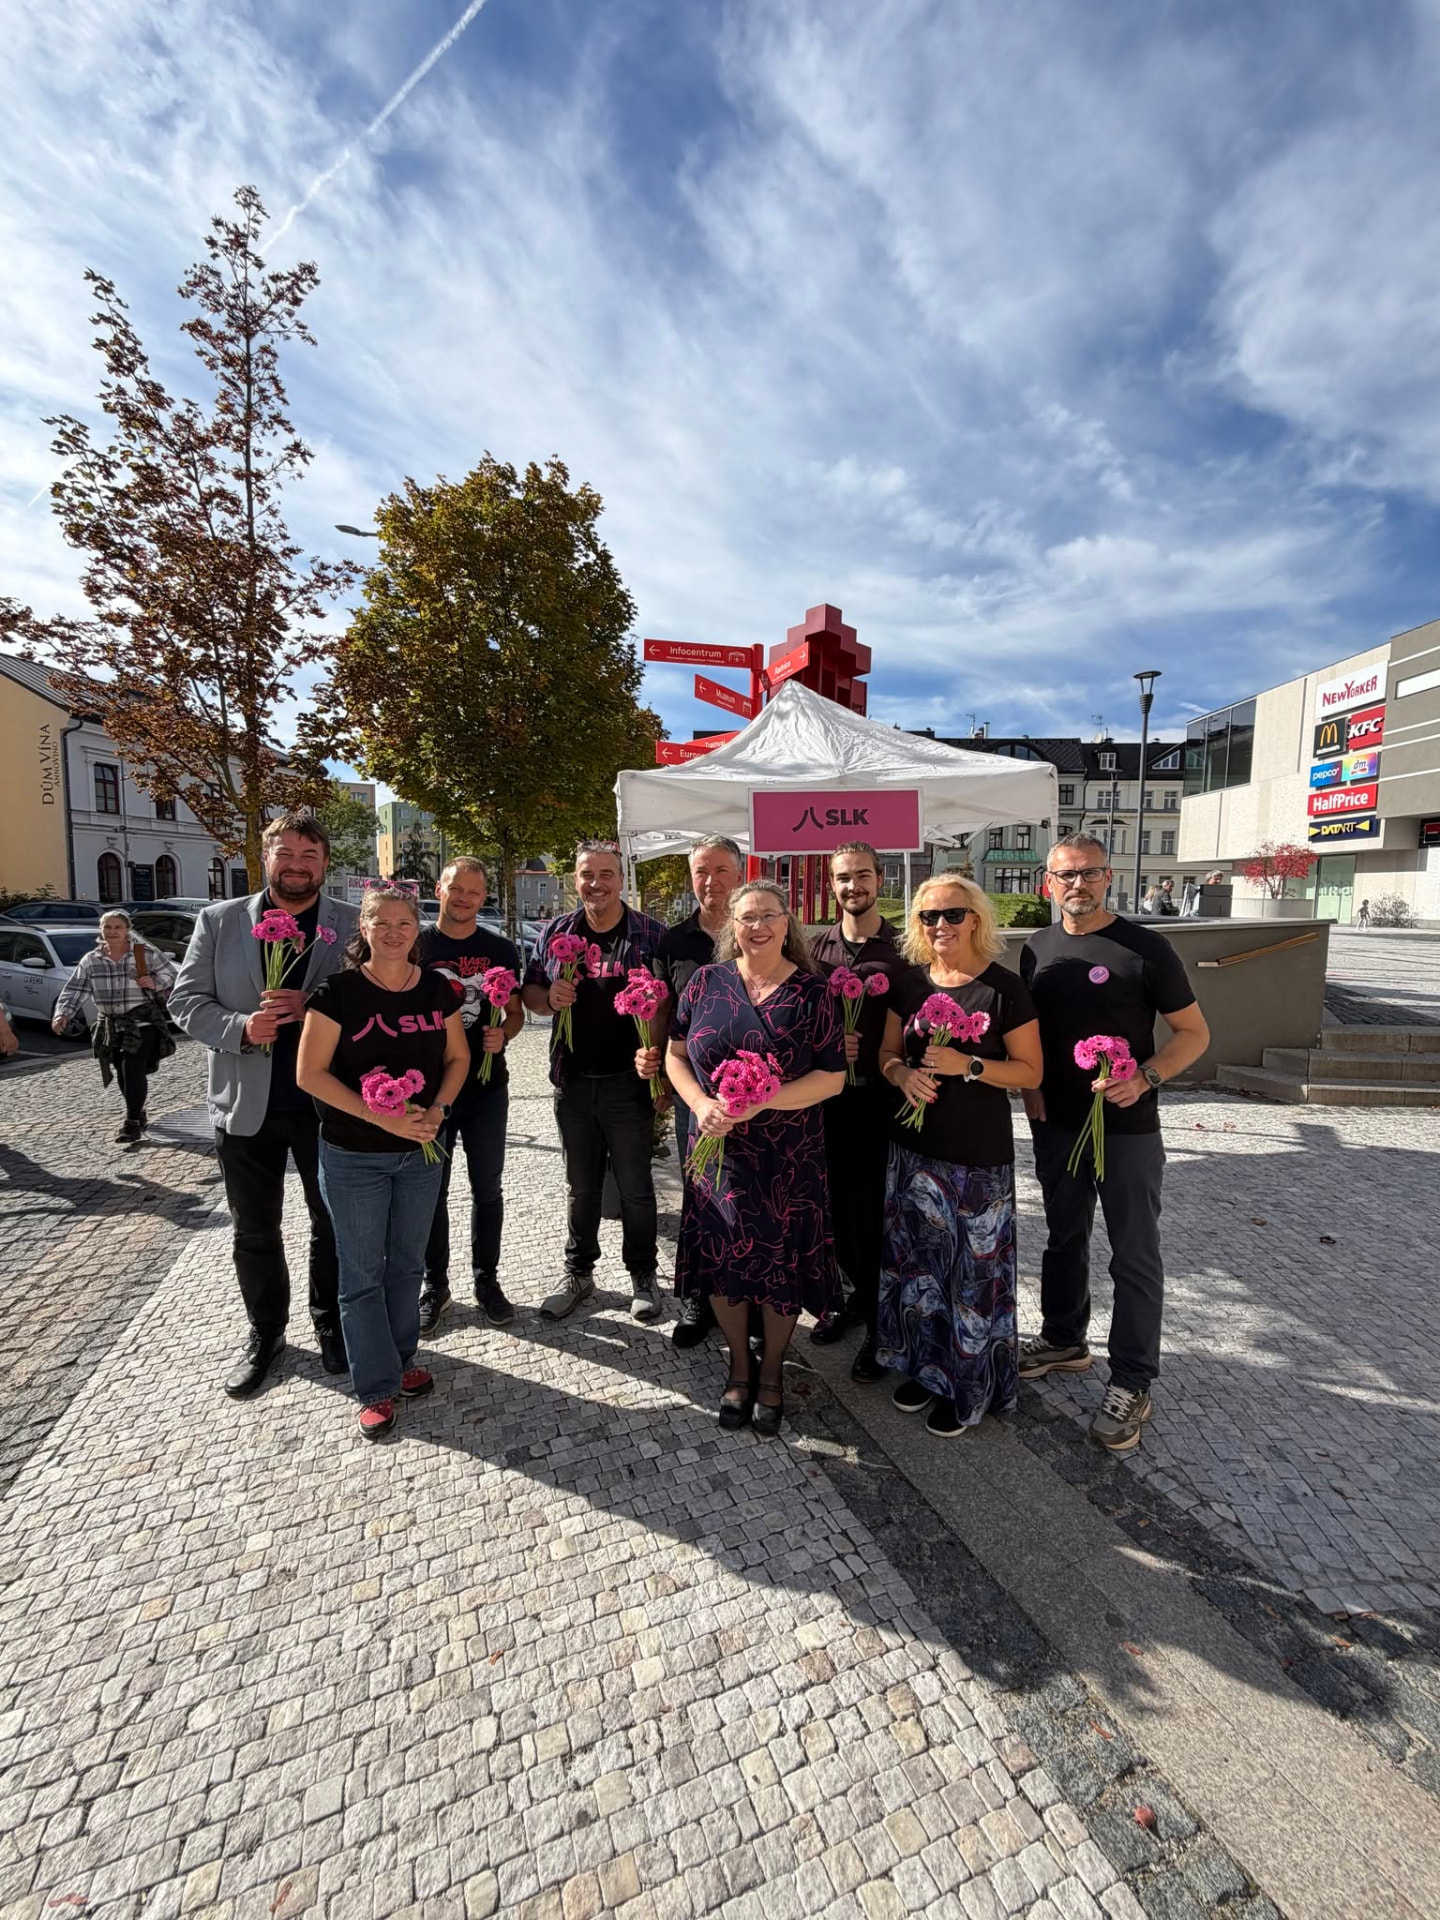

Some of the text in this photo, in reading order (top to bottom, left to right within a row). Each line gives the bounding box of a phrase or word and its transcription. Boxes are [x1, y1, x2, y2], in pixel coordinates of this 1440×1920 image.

[669, 646, 722, 657] Infocentrum
[1347, 717, 1384, 739] KFC
[37, 723, 55, 805] DŮM VÍNA
[1353, 760, 1367, 770] dm
[1312, 769, 1337, 781] pepco
[1312, 792, 1369, 812] HalfPrice
[825, 808, 869, 826] SLK
[1320, 822, 1357, 836] DATART
